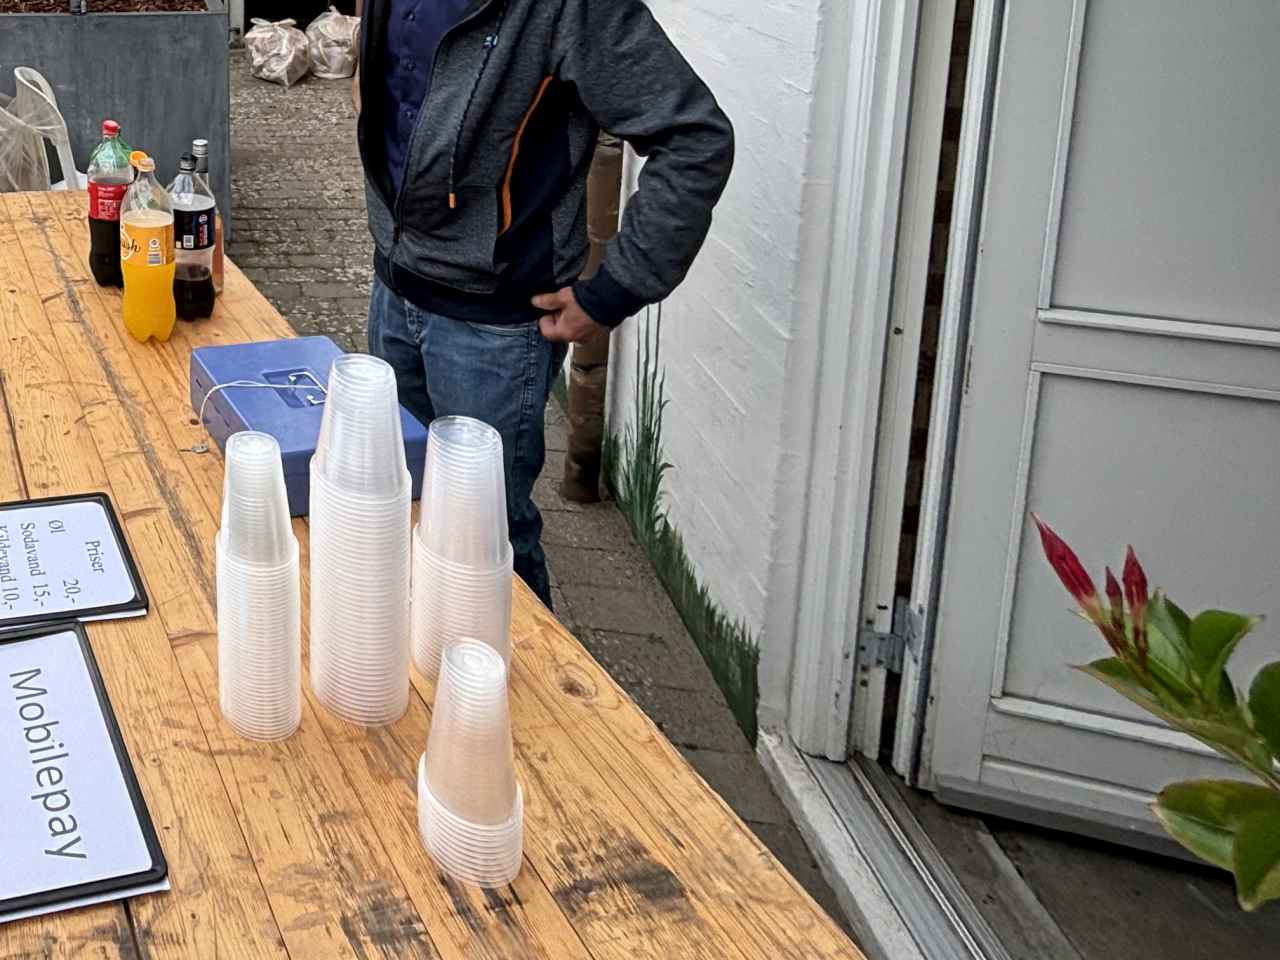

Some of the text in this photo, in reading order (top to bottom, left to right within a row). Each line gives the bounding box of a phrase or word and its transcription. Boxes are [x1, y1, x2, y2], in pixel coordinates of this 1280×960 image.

[2, 586, 20, 611] 10,-
[19, 522, 50, 608] Sodavand 15,-
[48, 519, 81, 605] Øl 20,-
[84, 540, 105, 574] Priser
[9, 667, 88, 860] Mobilepay
